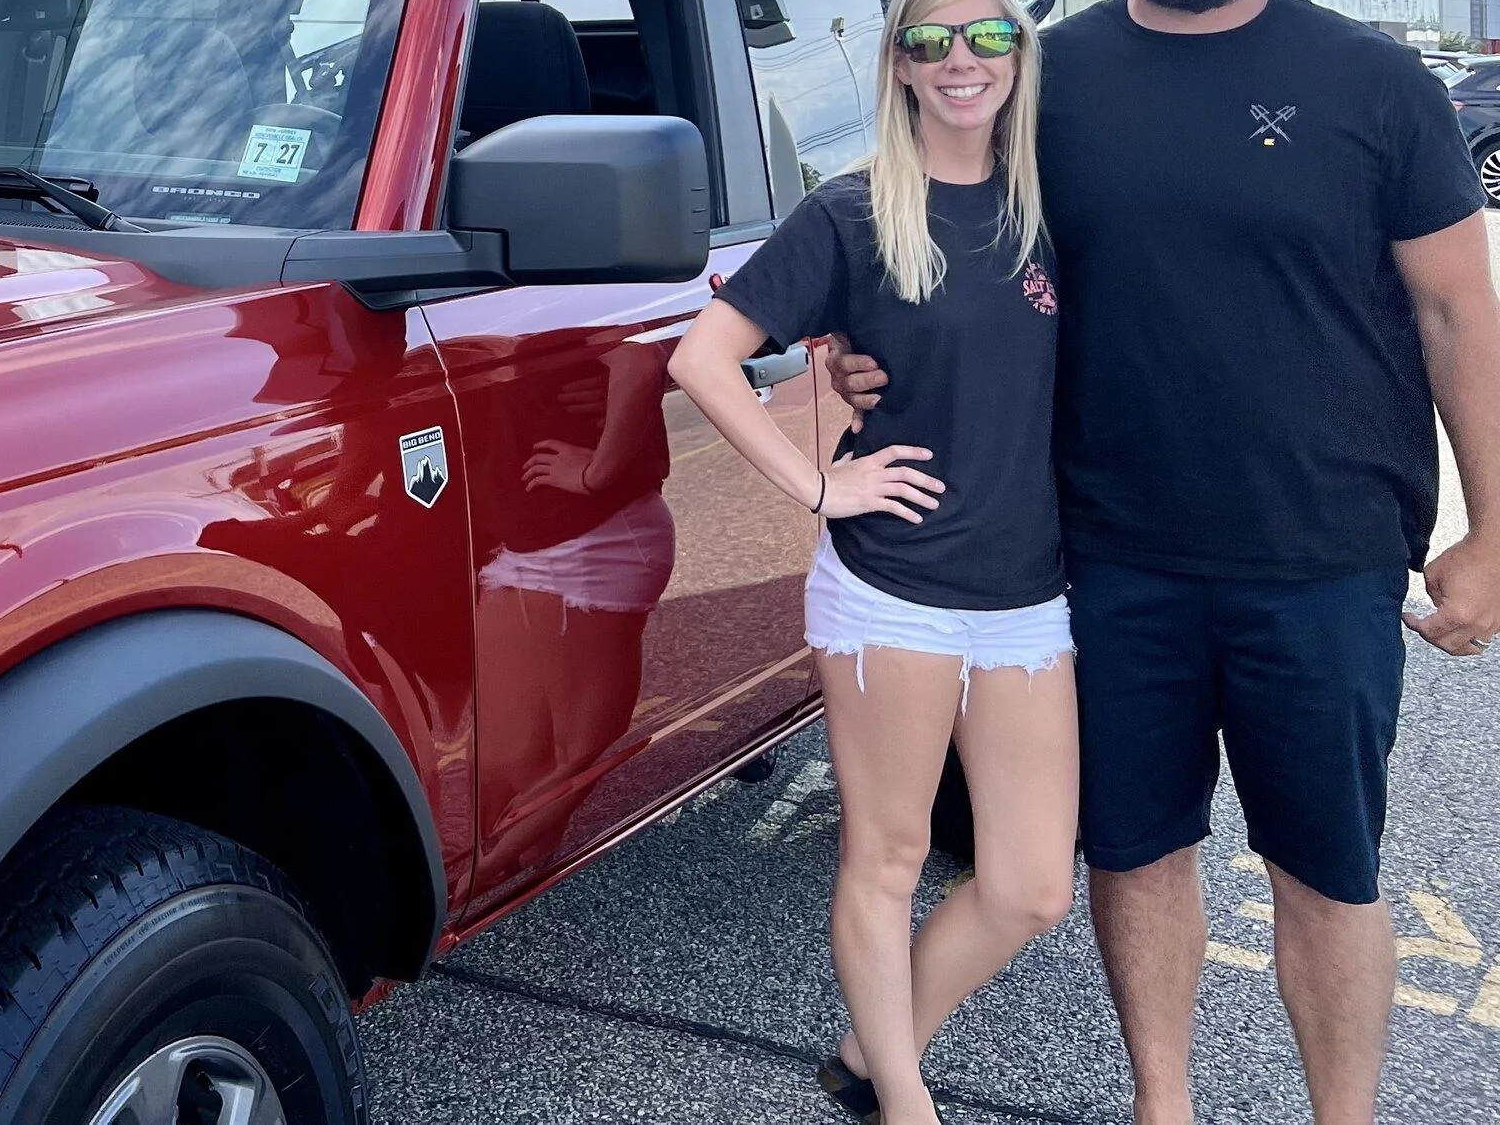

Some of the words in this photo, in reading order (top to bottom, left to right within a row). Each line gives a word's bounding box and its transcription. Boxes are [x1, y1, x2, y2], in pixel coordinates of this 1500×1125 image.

[253, 142, 268, 163] 7
[276, 143, 301, 165] 27
[152, 186, 260, 199] BRONCO
[1022, 279, 1045, 296] SALT
[402, 438, 418, 449] BIG
[418, 431, 441, 444] BEND
